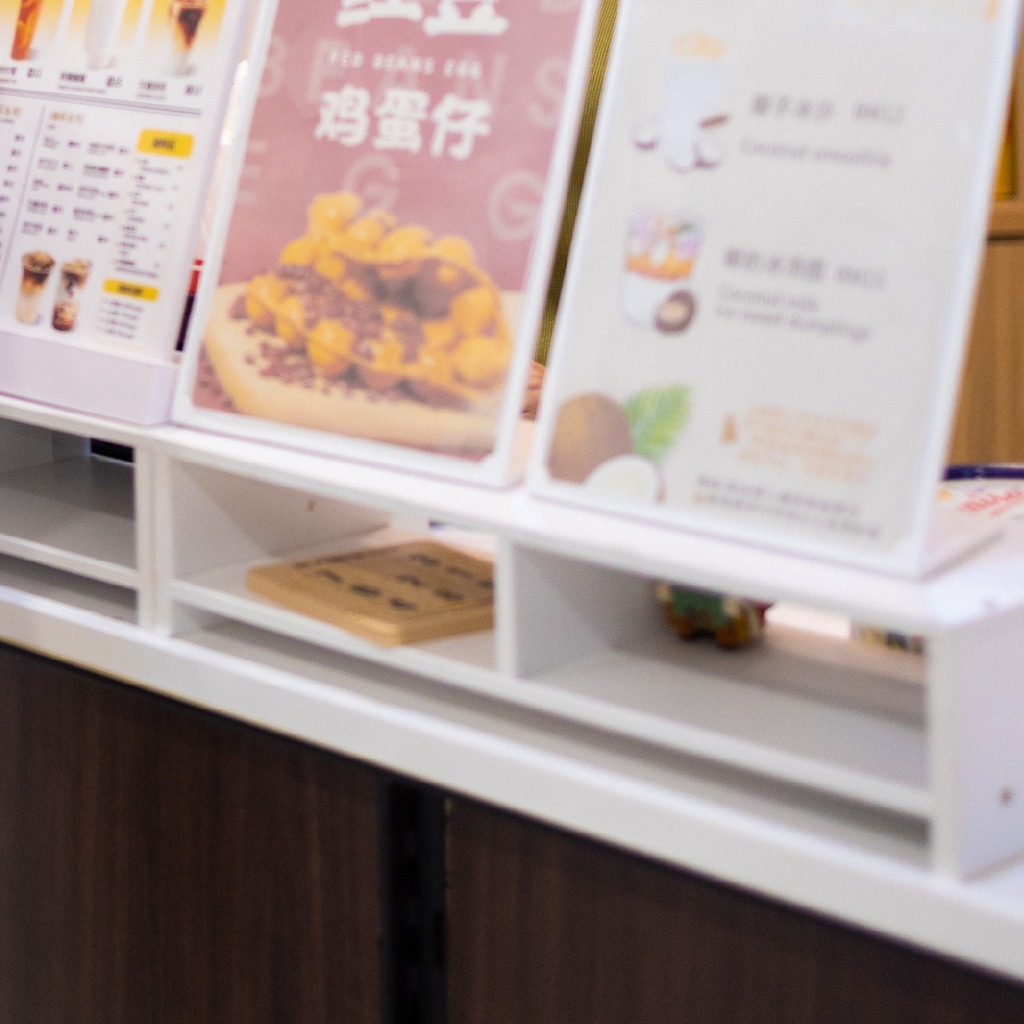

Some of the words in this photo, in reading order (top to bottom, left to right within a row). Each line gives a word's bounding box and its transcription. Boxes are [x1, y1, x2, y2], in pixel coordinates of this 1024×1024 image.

[327, 48, 364, 68] RED
[372, 53, 435, 74] BEANS
[314, 83, 492, 161] 鸡蛋仔
